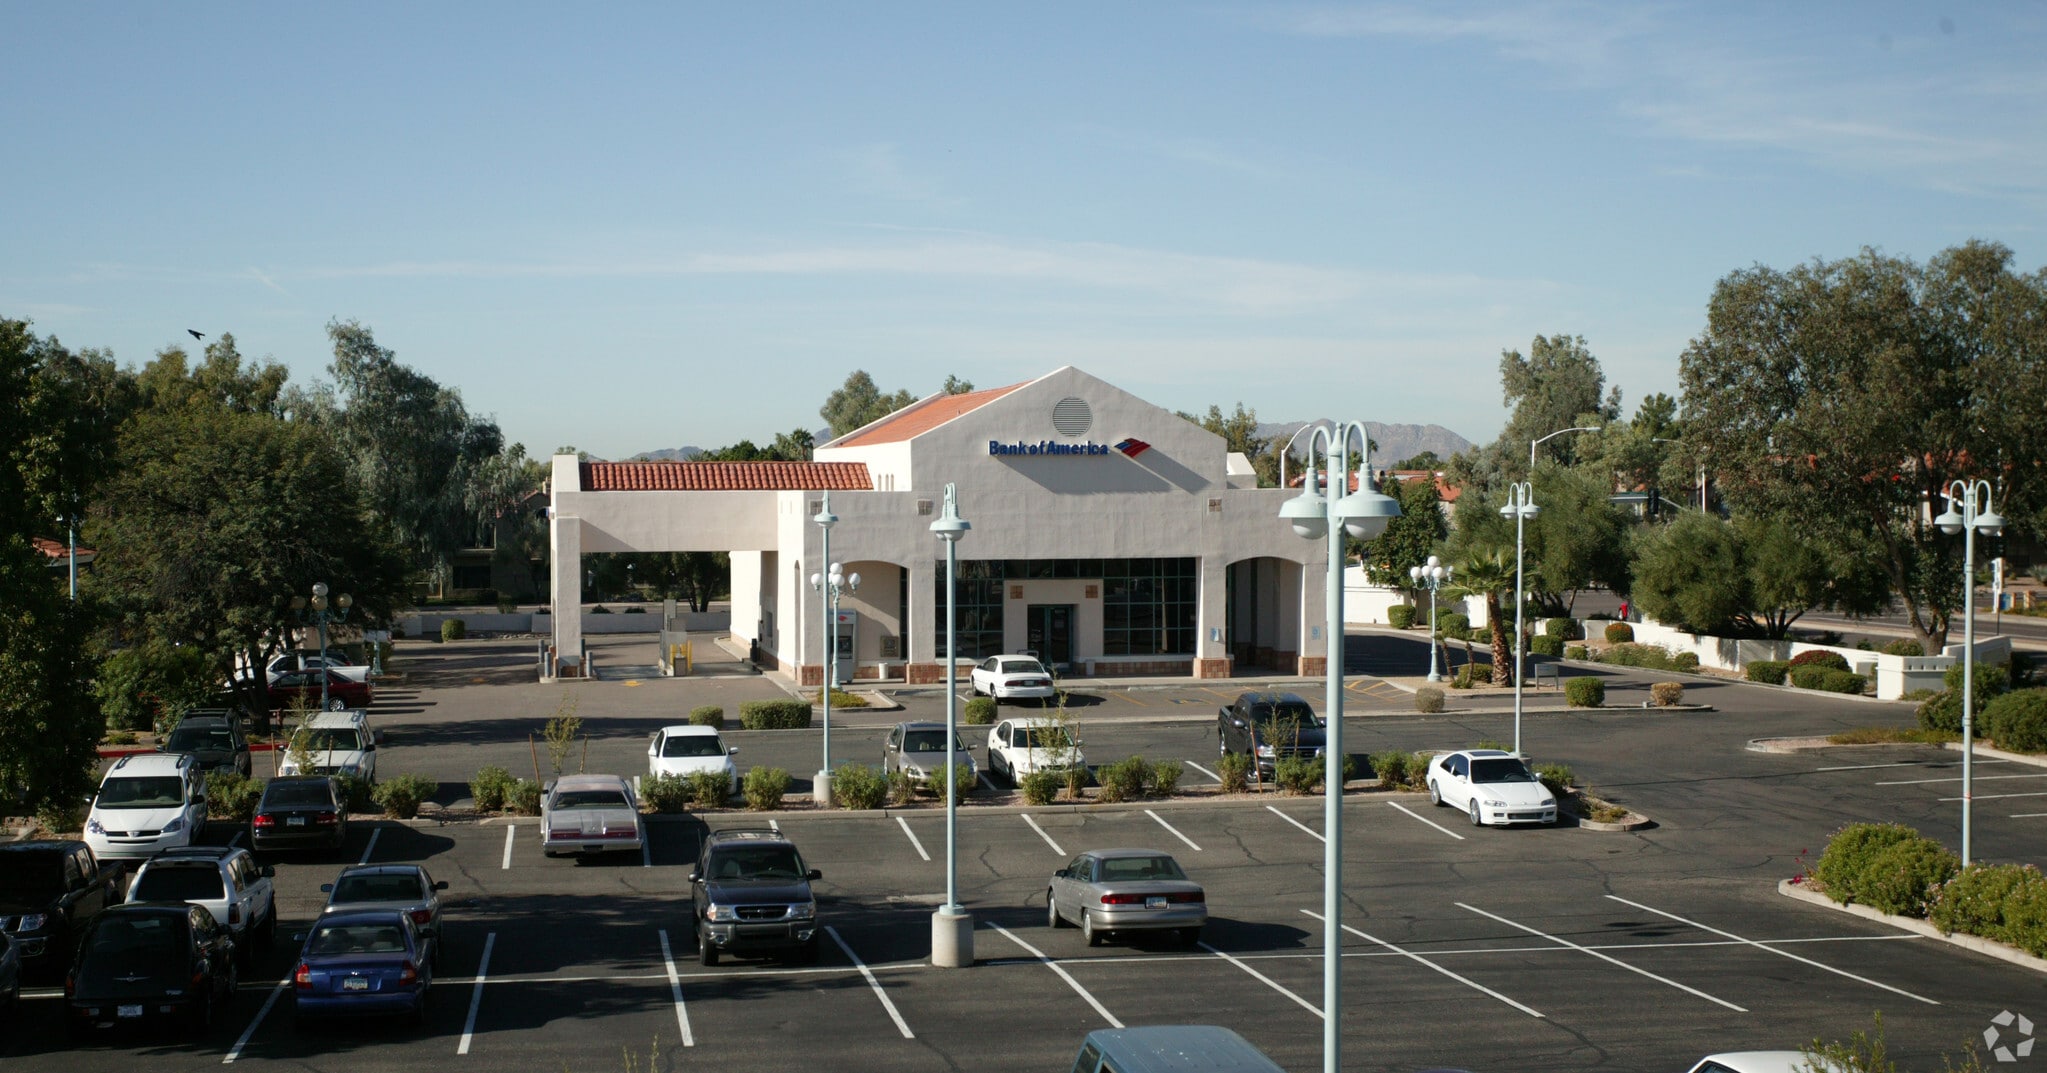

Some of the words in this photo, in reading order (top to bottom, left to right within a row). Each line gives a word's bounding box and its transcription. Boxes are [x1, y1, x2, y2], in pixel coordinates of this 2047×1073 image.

[989, 441, 1028, 455] Bank
[1029, 441, 1045, 455] of
[1047, 441, 1108, 455] America
